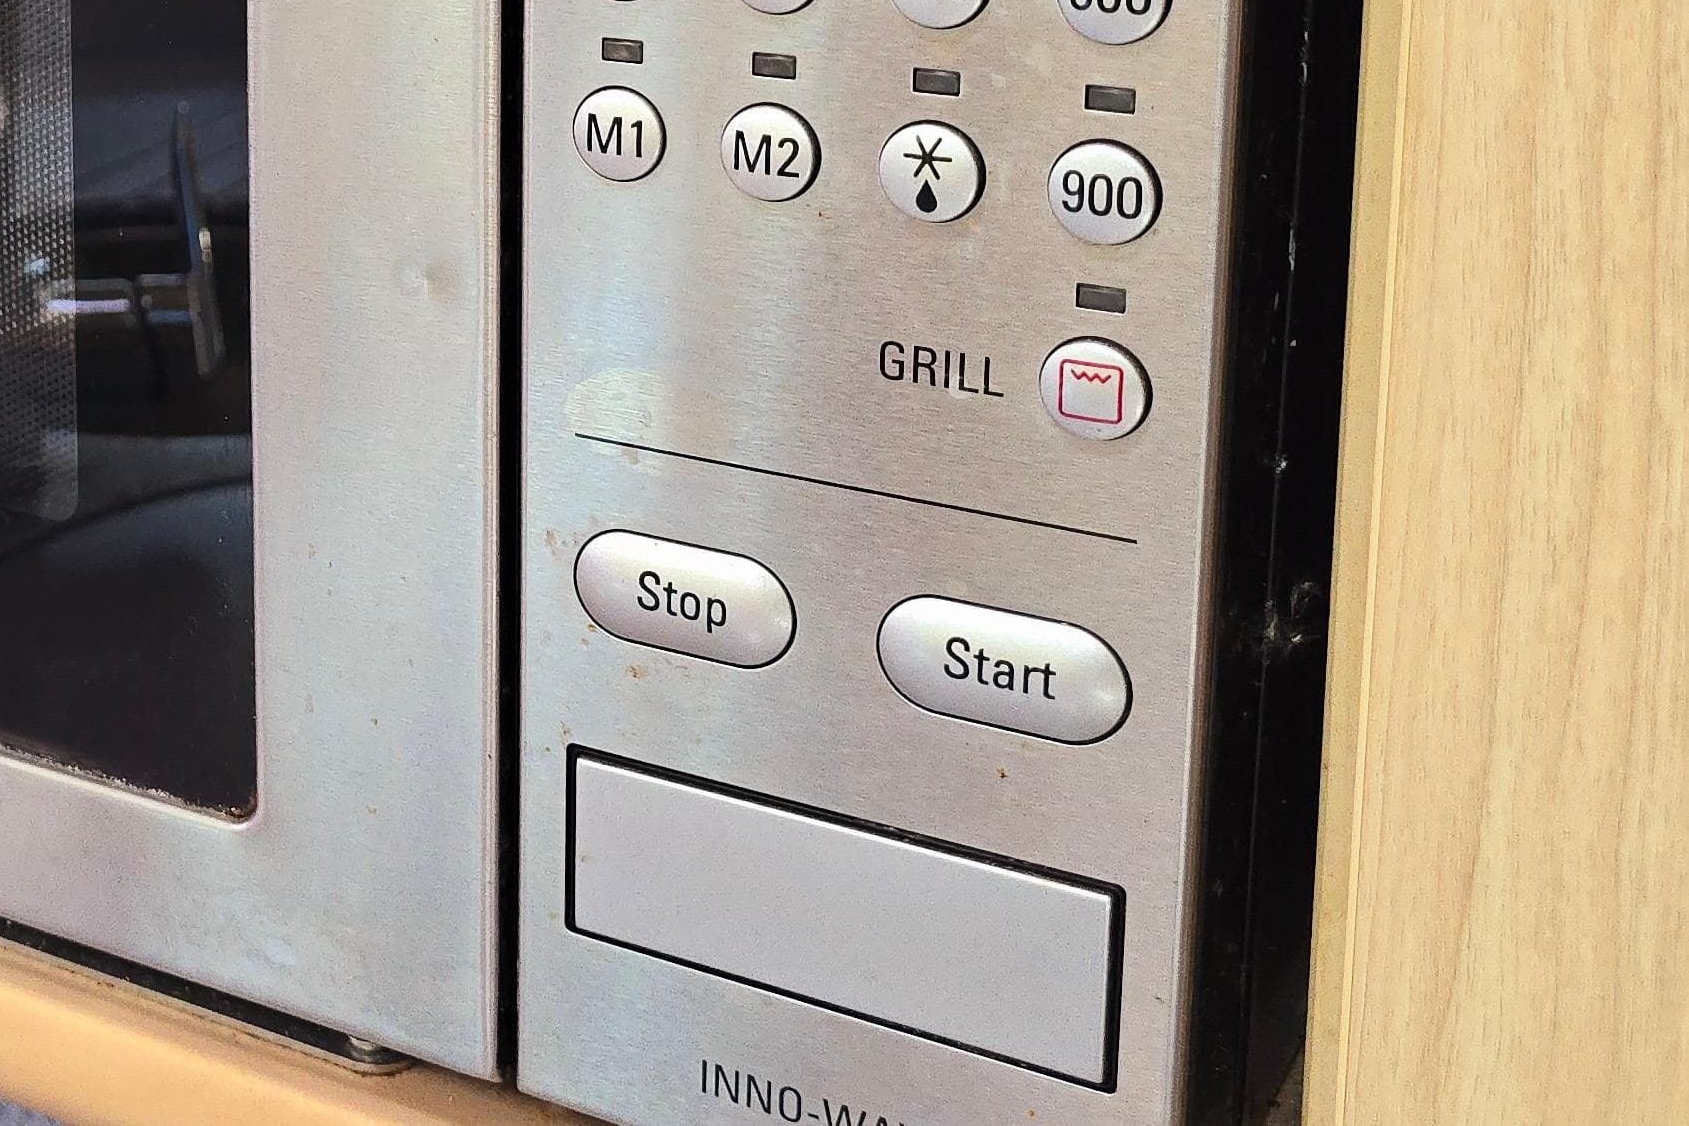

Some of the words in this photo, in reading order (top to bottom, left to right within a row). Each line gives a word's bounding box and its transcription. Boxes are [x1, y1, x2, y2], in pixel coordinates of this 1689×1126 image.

[586, 113, 645, 160] M1
[733, 129, 800, 179] M2
[1061, 170, 1143, 220] 900
[879, 340, 1005, 398] GRILL
[636, 570, 728, 632] Stop
[943, 636, 1057, 701] Start
[702, 1060, 905, 1126] INNO-W
